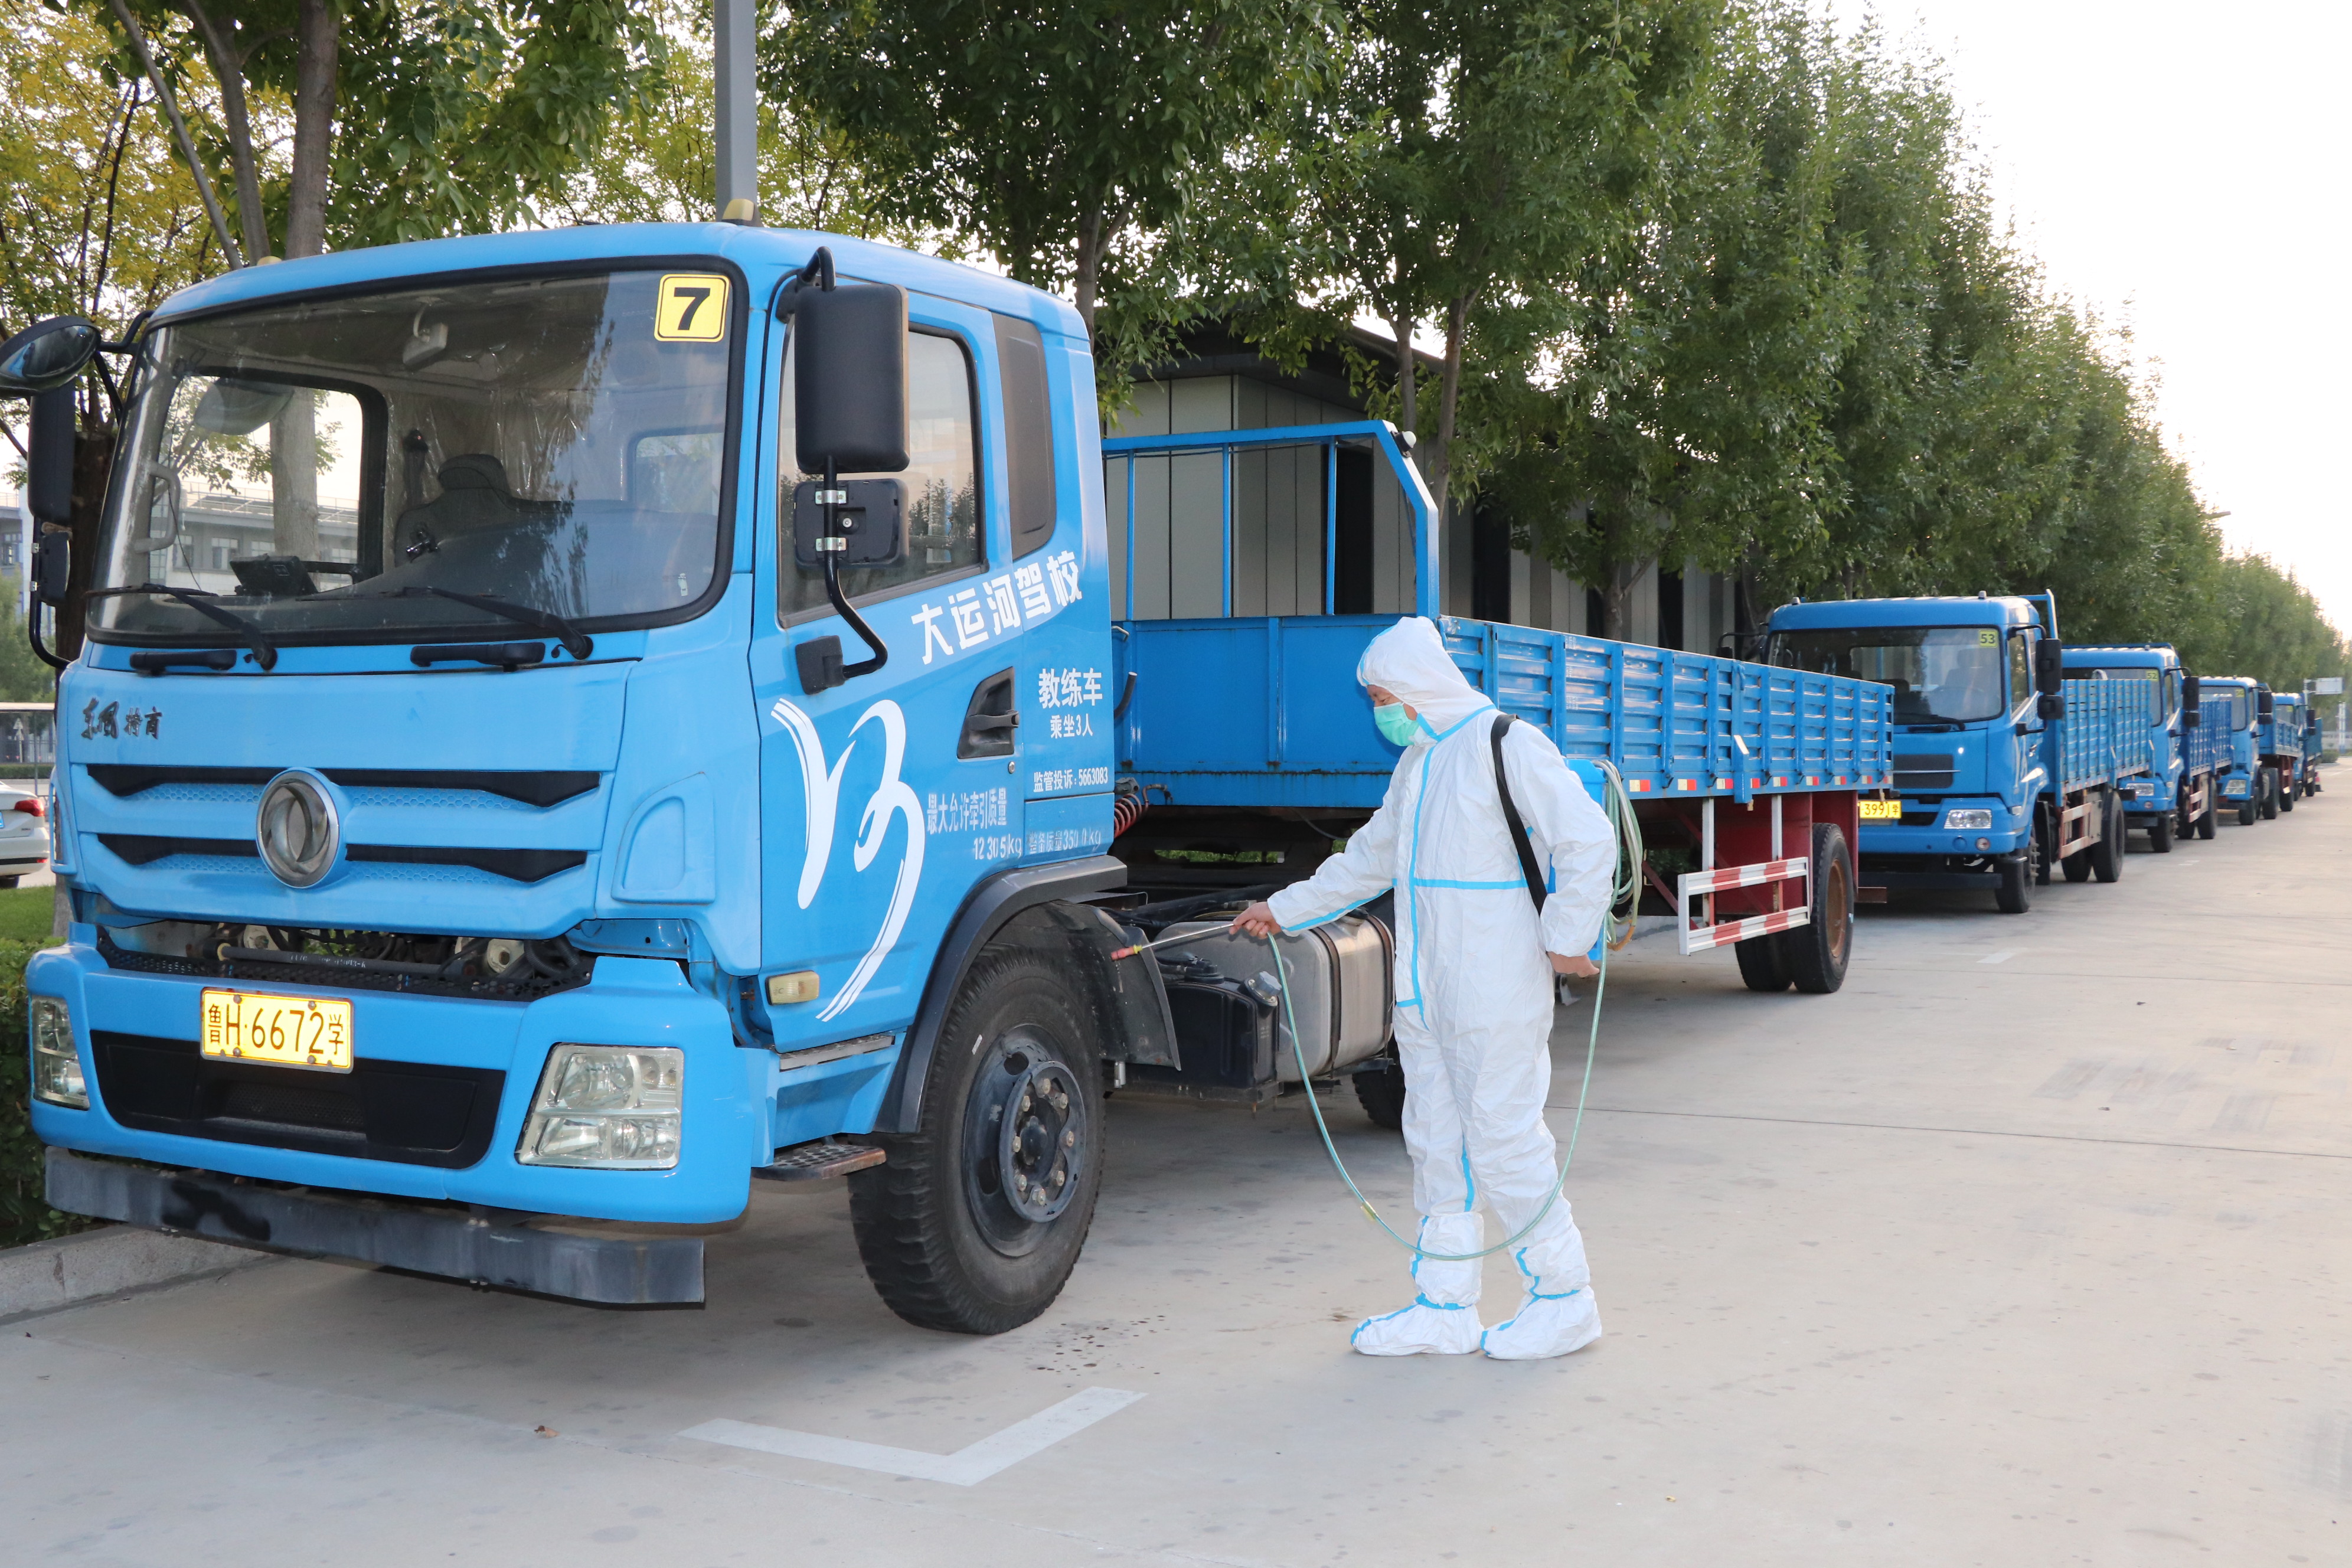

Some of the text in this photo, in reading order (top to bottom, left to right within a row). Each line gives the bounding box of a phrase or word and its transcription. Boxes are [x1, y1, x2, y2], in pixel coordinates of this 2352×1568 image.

[674, 287, 710, 330] 7
[911, 550, 1082, 665] 大运河驾校
[1981, 633, 1995, 643] 53
[1038, 668, 1103, 708] 教练车
[1050, 713, 1093, 739] 乘坐3人
[927, 787, 1007, 835] 最大允许牵引质量
